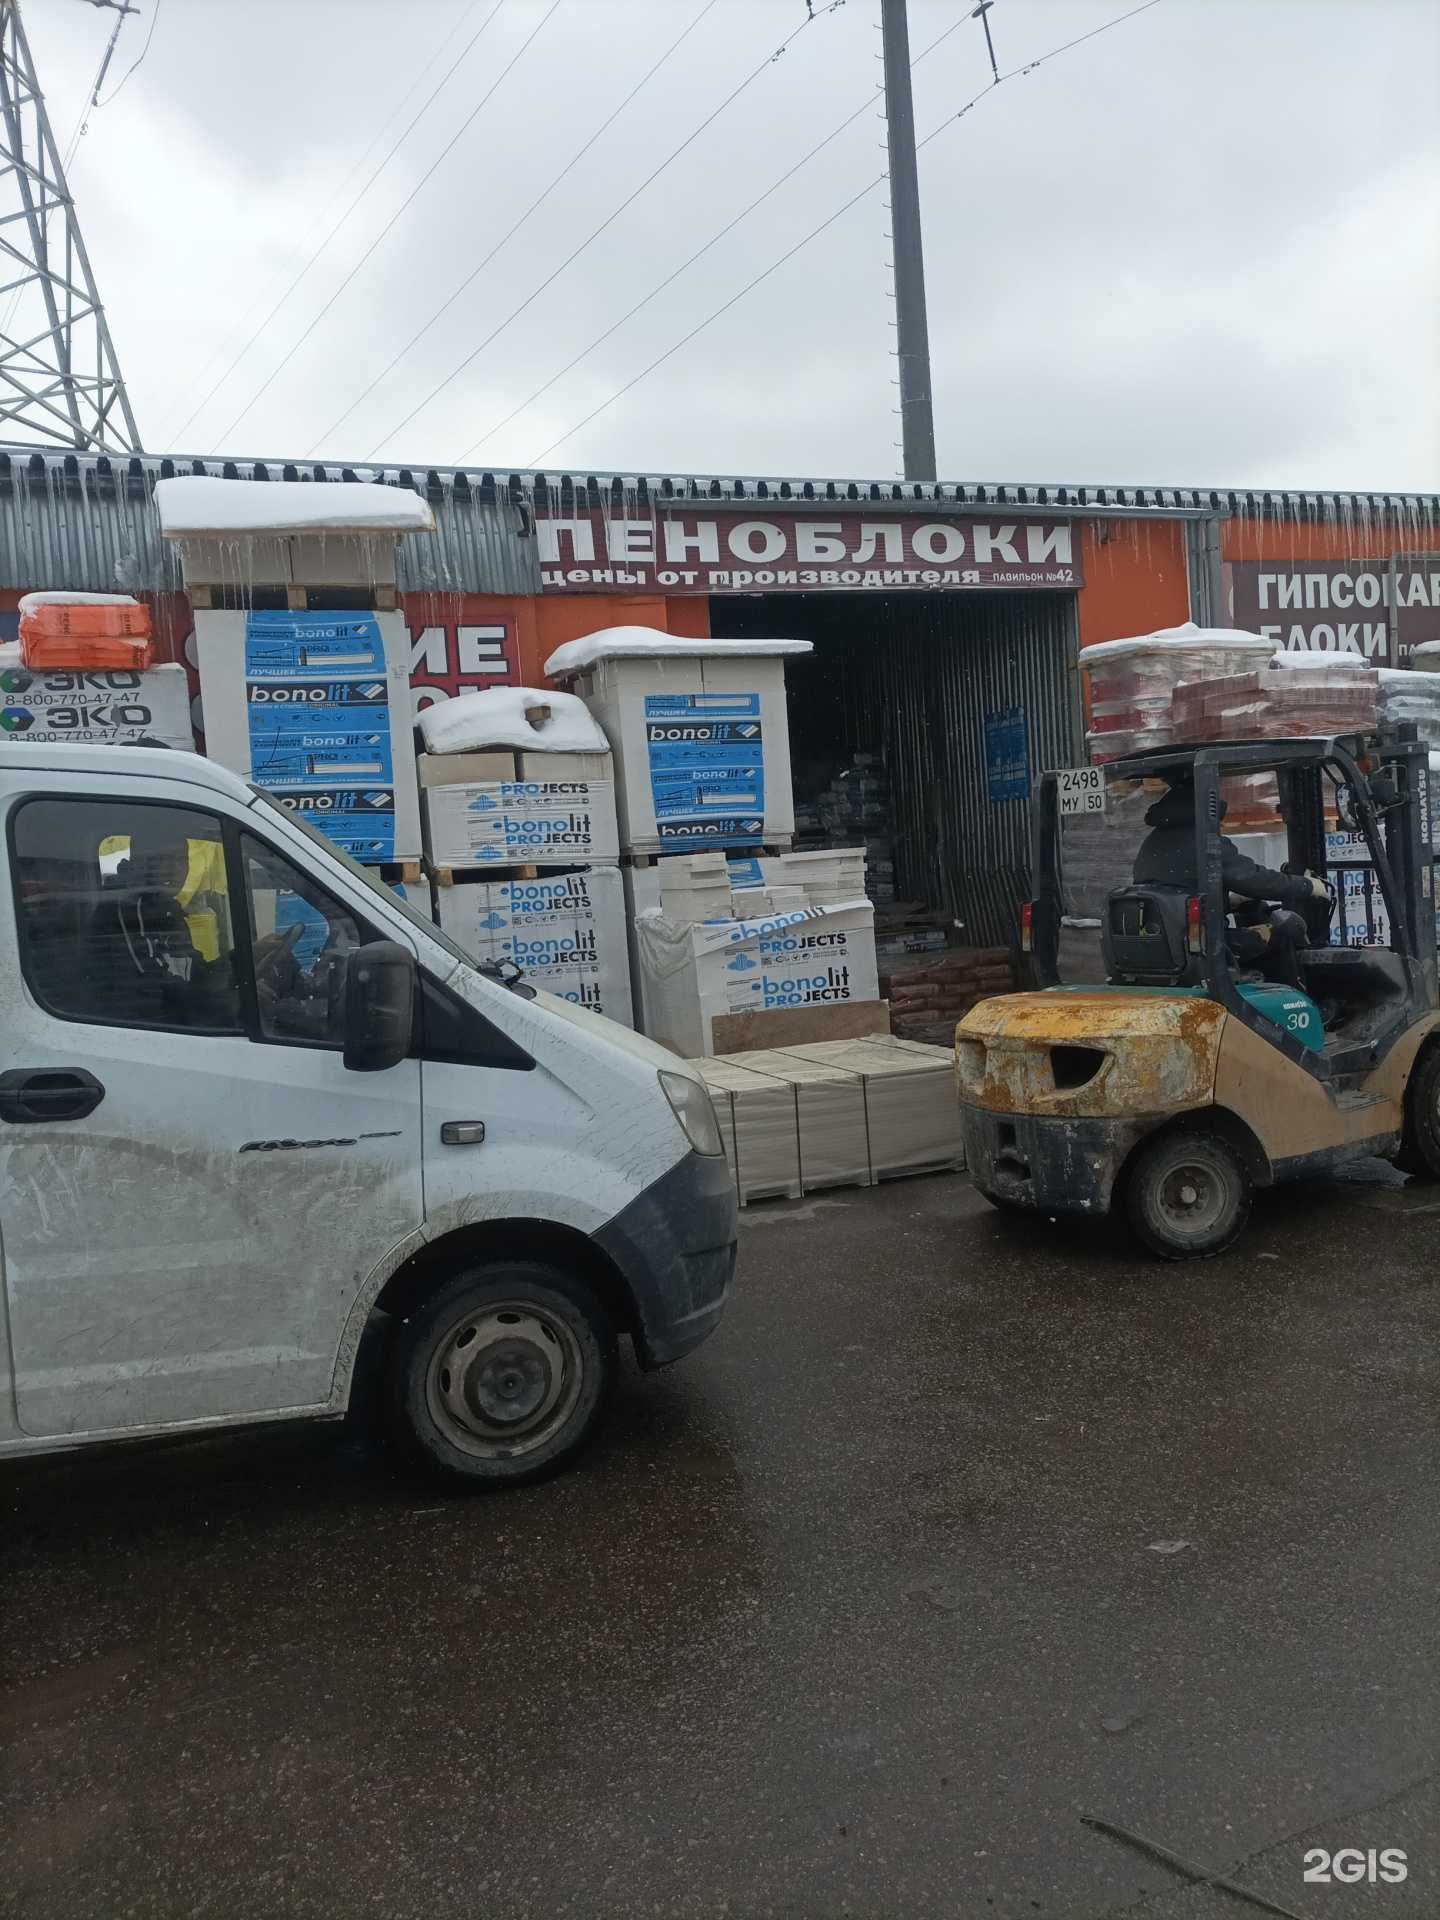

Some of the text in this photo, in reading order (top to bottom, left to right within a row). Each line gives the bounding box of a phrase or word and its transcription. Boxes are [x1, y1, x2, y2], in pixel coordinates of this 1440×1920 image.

[535, 519, 1073, 563] ПЕНОБЛОКИ
[542, 569, 980, 588] цены от производителя
[295, 624, 348, 638] bonolit
[1260, 622, 1387, 657] БЛОКИ
[44, 671, 142, 690] ЭКО
[5, 692, 140, 706] 8-800-770-47-47
[251, 684, 350, 702] bonolit
[46, 705, 152, 729] ЭКО
[9, 728, 147, 743] 8-800-770-47-47
[302, 735, 360, 746] bonolit
[650, 724, 731, 740] bonolit
[692, 768, 739, 780] bonolit
[1062, 770, 1099, 791] 2498
[501, 783, 589, 796] PROJECTS
[281, 793, 358, 810] onolit
[1087, 795, 1102, 809] 50
[1418, 768, 1430, 844] KOMATSU
[504, 814, 591, 834] bonolit
[661, 820, 736, 837] bonolit
[506, 833, 592, 845] PROJECTS
[511, 877, 588, 900] bonolit
[511, 896, 592, 914] PROJECTS
[513, 929, 596, 955] bonolit
[760, 932, 847, 954] PROJECTS
[514, 950, 598, 967] PROJECTS
[763, 966, 849, 995] bonolit
[765, 986, 850, 1008] PROJECTS
[1287, 1012, 1310, 1031] 30
